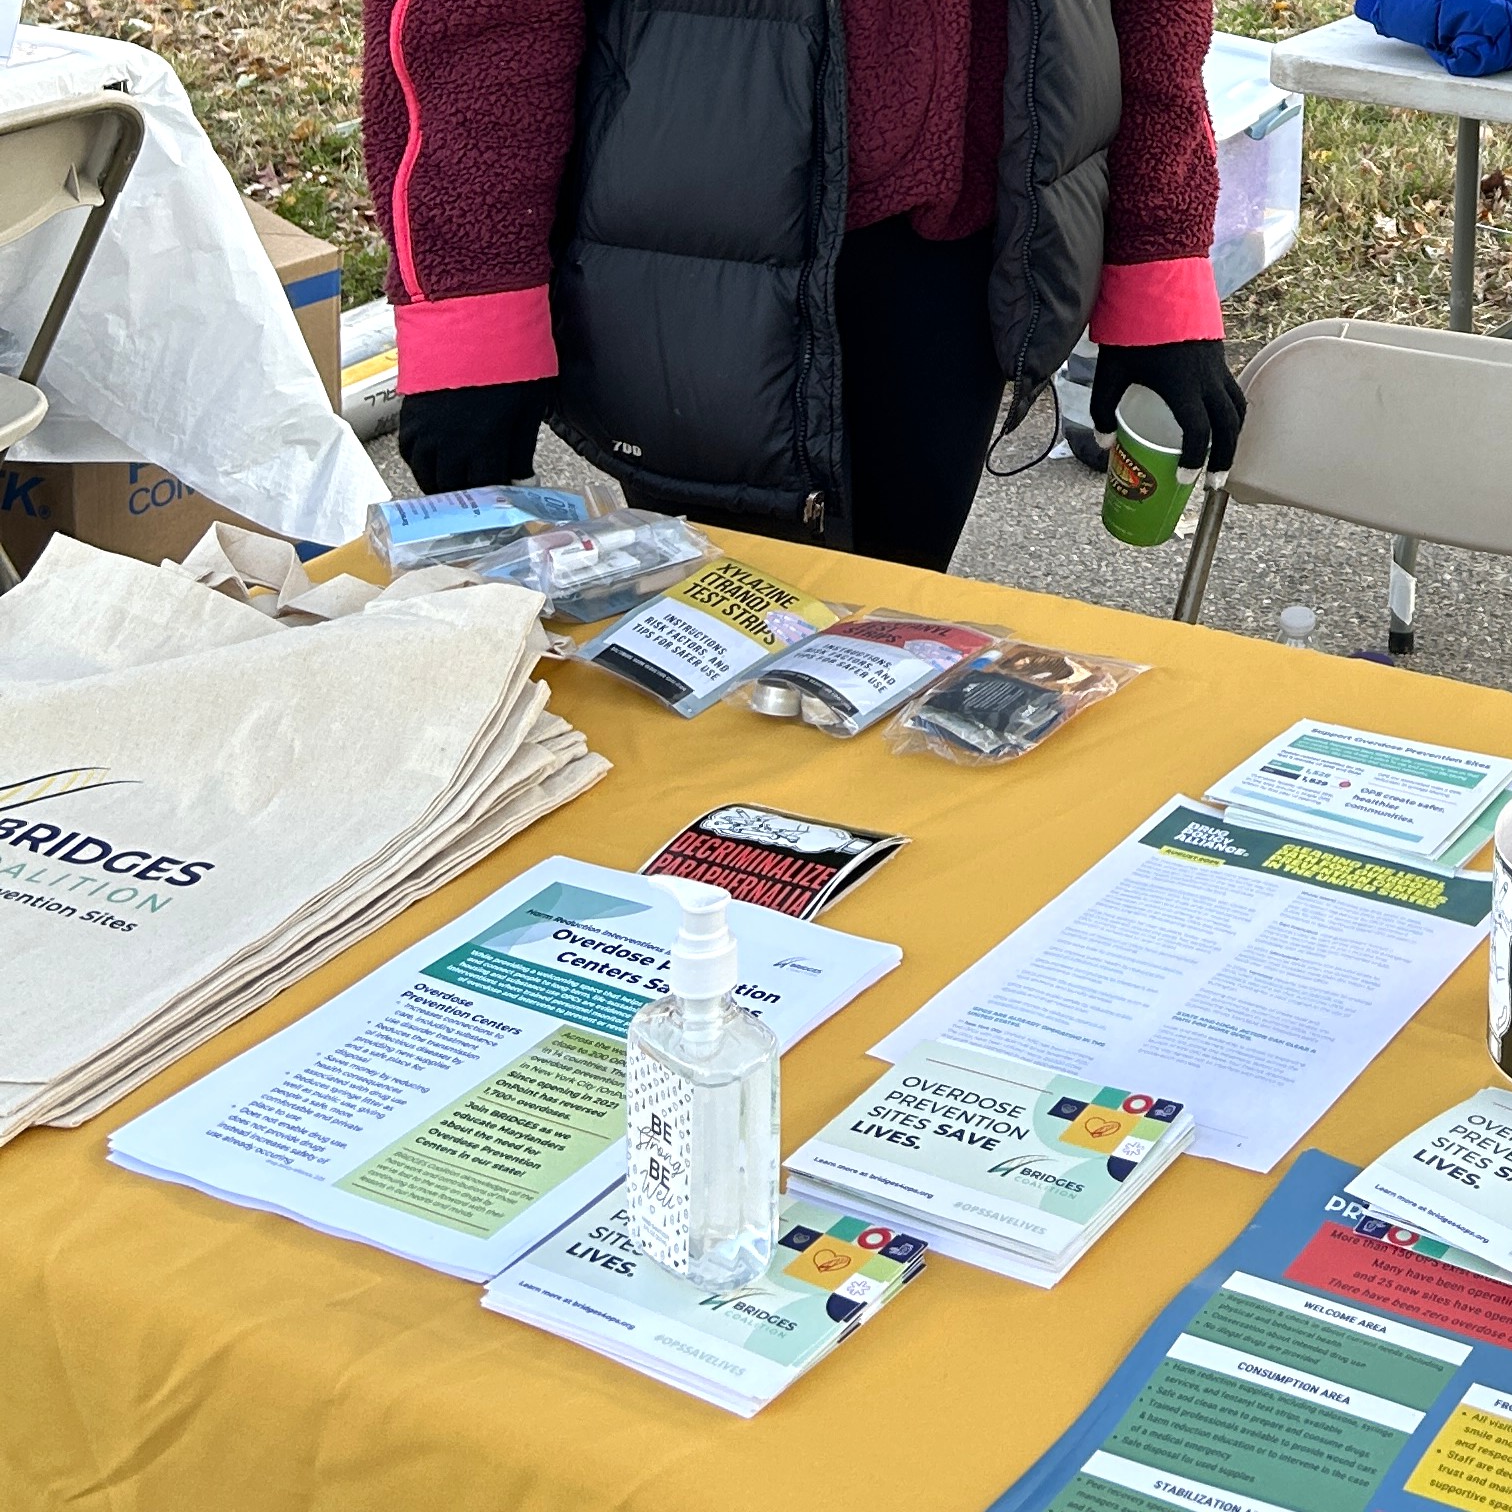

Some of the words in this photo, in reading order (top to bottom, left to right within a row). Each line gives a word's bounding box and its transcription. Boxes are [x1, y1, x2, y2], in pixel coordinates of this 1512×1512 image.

[716, 563, 800, 609] XYLAZINE
[683, 583, 730, 608] TEST
[722, 603, 776, 646] STRIPS
[632, 623, 655, 639] TIPS
[652, 633, 671, 650] FOR
[671, 642, 701, 667] SAFER
[701, 666, 721, 681] USE
[644, 616, 670, 634] RISK
[666, 626, 708, 658] FACTORS,
[708, 656, 730, 672] AND
[663, 613, 728, 658] INSTRUCTIONS,
[817, 655, 838, 666] FOR
[837, 659, 867, 679] SAFER
[867, 677, 888, 694] USE
[823, 643, 893, 671] INSTRUCTIONS,
[831, 651, 871, 670] FACTORS,
[874, 669, 897, 685] AND
[0, 818, 215, 886] BRIDGES
[668, 831, 837, 890] DECRIMINALIZE
[649, 853, 813, 916] PARAPHERNALIA
[79, 909, 138, 933] Sites
[552, 928, 656, 967] Overdose
[556, 951, 643, 985] Centers
[401, 990, 471, 1020] Prevention
[471, 1013, 523, 1036] Centers
[414, 982, 474, 1008] Overdose
[506, 1070, 537, 1087] Since
[537, 1077, 581, 1101] opening
[581, 1090, 594, 1101] in
[594, 1094, 619, 1109] 2021
[902, 1076, 1027, 1119] OVERDOSE
[651, 1112, 672, 1146] BE
[850, 1121, 922, 1150] LIVES.
[866, 1106, 931, 1131] SITES
[932, 1123, 1001, 1153] SAVE
[884, 1090, 1030, 1141] PREVENTION
[636, 1126, 685, 1178] Strong
[1412, 1149, 1480, 1190] LIVES.
[1431, 1135, 1495, 1172] SITES
[640, 1169, 676, 1210] Well
[648, 1157, 671, 1191] BE
[1020, 1167, 1086, 1194] BRIDGES
[1371, 1258, 1405, 1277] Many
[1405, 1268, 1434, 1285] have
[1436, 1276, 1465, 1294] been
[1304, 1300, 1358, 1326] WELCOME
[1356, 1317, 1388, 1334] AREA
[1237, 1361, 1320, 1396] CONSUMPTION
[1319, 1387, 1351, 1405] AREA
